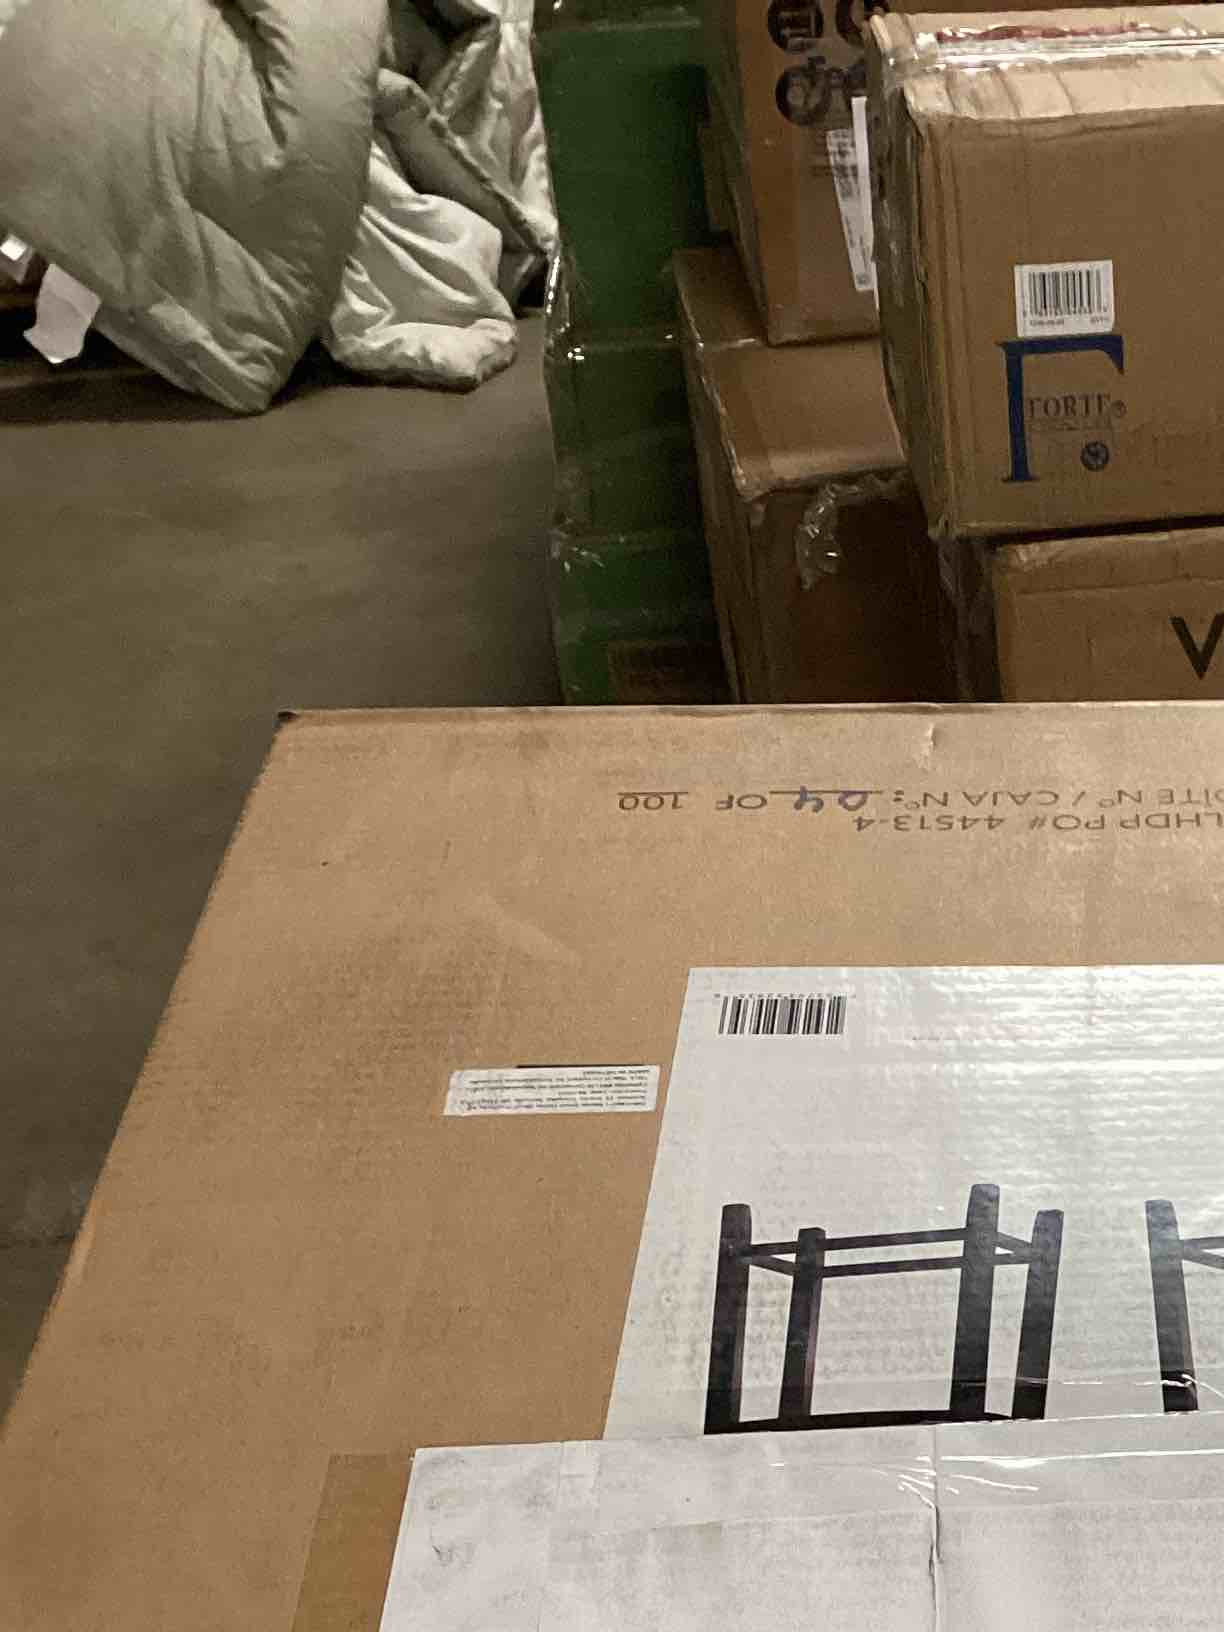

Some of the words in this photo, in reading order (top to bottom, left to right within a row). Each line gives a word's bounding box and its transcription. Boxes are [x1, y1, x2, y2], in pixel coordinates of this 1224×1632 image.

[617, 793, 684, 811] 100
[714, 793, 768, 811] OF
[961, 789, 1060, 807] CAJA
[851, 814, 1007, 832] 44513-4
[1028, 813, 1105, 831] PO#
[1119, 812, 1224, 830] LHDP
